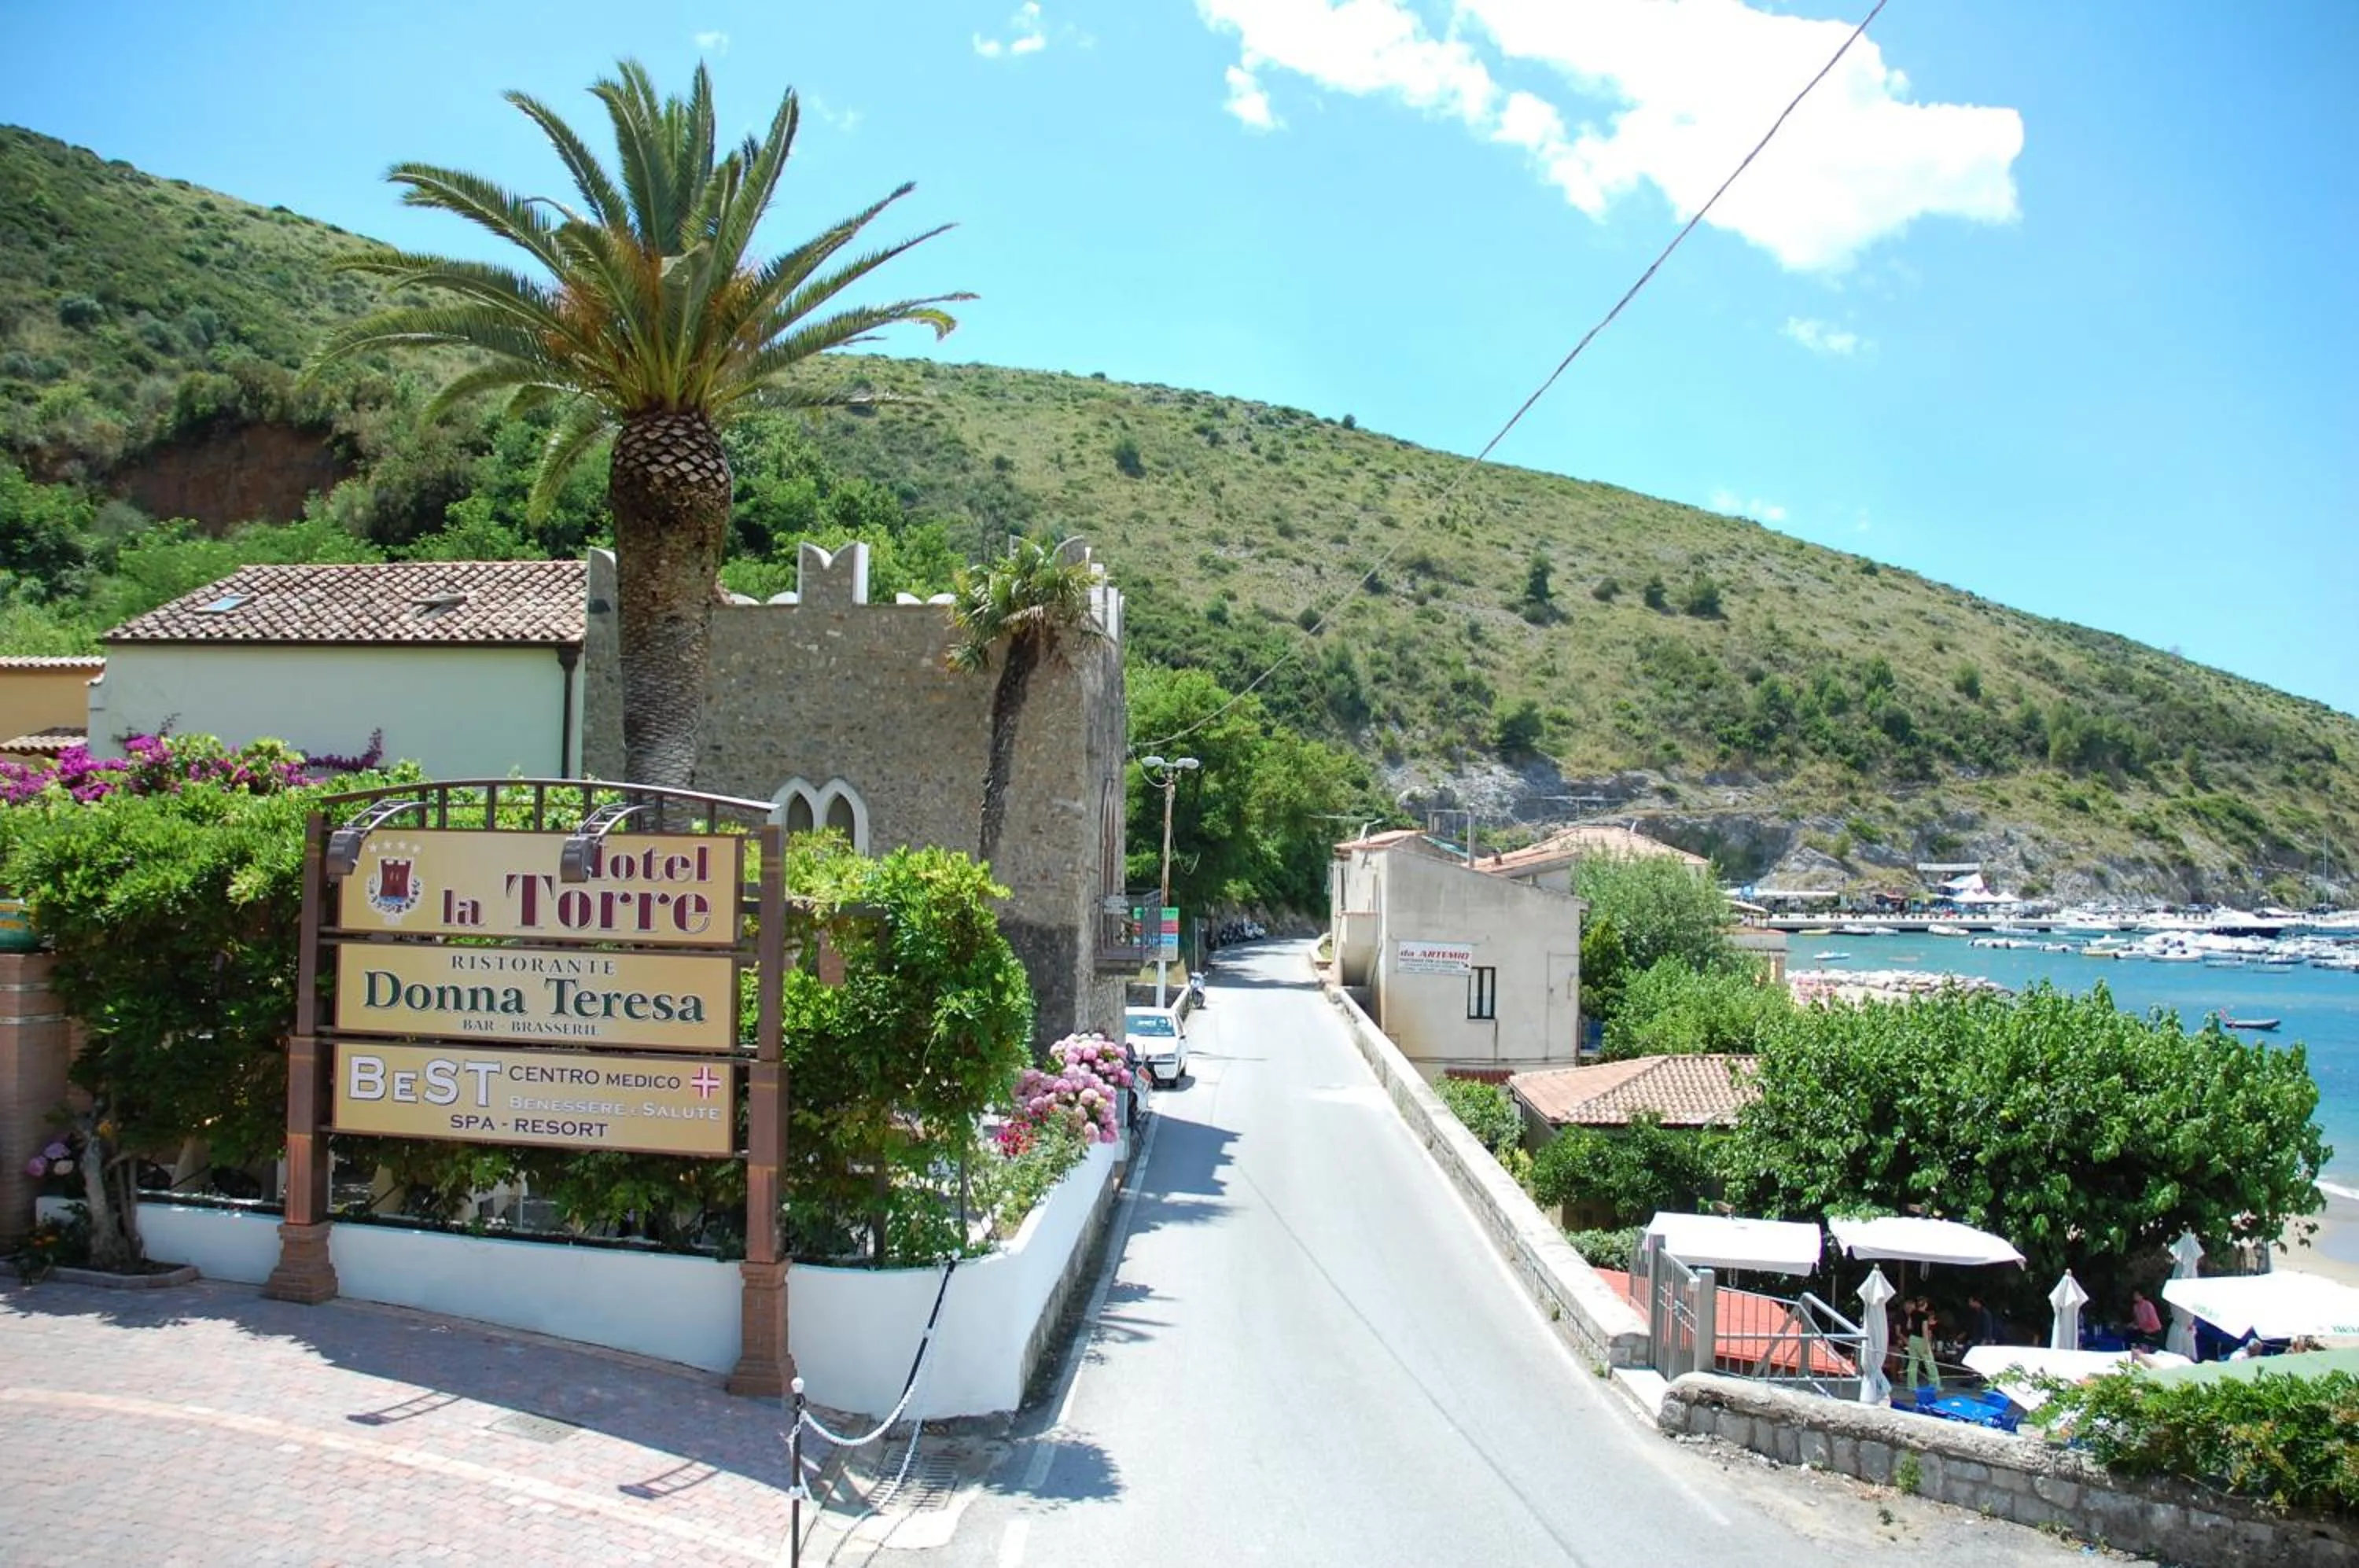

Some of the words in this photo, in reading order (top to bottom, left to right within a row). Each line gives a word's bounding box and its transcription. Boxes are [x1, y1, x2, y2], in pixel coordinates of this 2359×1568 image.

[440, 889, 488, 927] la
[505, 874, 712, 934] Torre
[451, 955, 616, 975] RISTORANTE
[363, 970, 528, 1016] Donna
[544, 977, 705, 1022] Teresa
[462, 1019, 495, 1032] BAR
[511, 1021, 600, 1036] BRASSERIE
[509, 1066, 600, 1085] CENTRO
[605, 1073, 681, 1090] MEDICO
[510, 1096, 625, 1117] BENESSERE
[642, 1101, 722, 1120] SALUTE
[450, 1114, 495, 1131] SPA
[513, 1119, 609, 1137] RESORT
